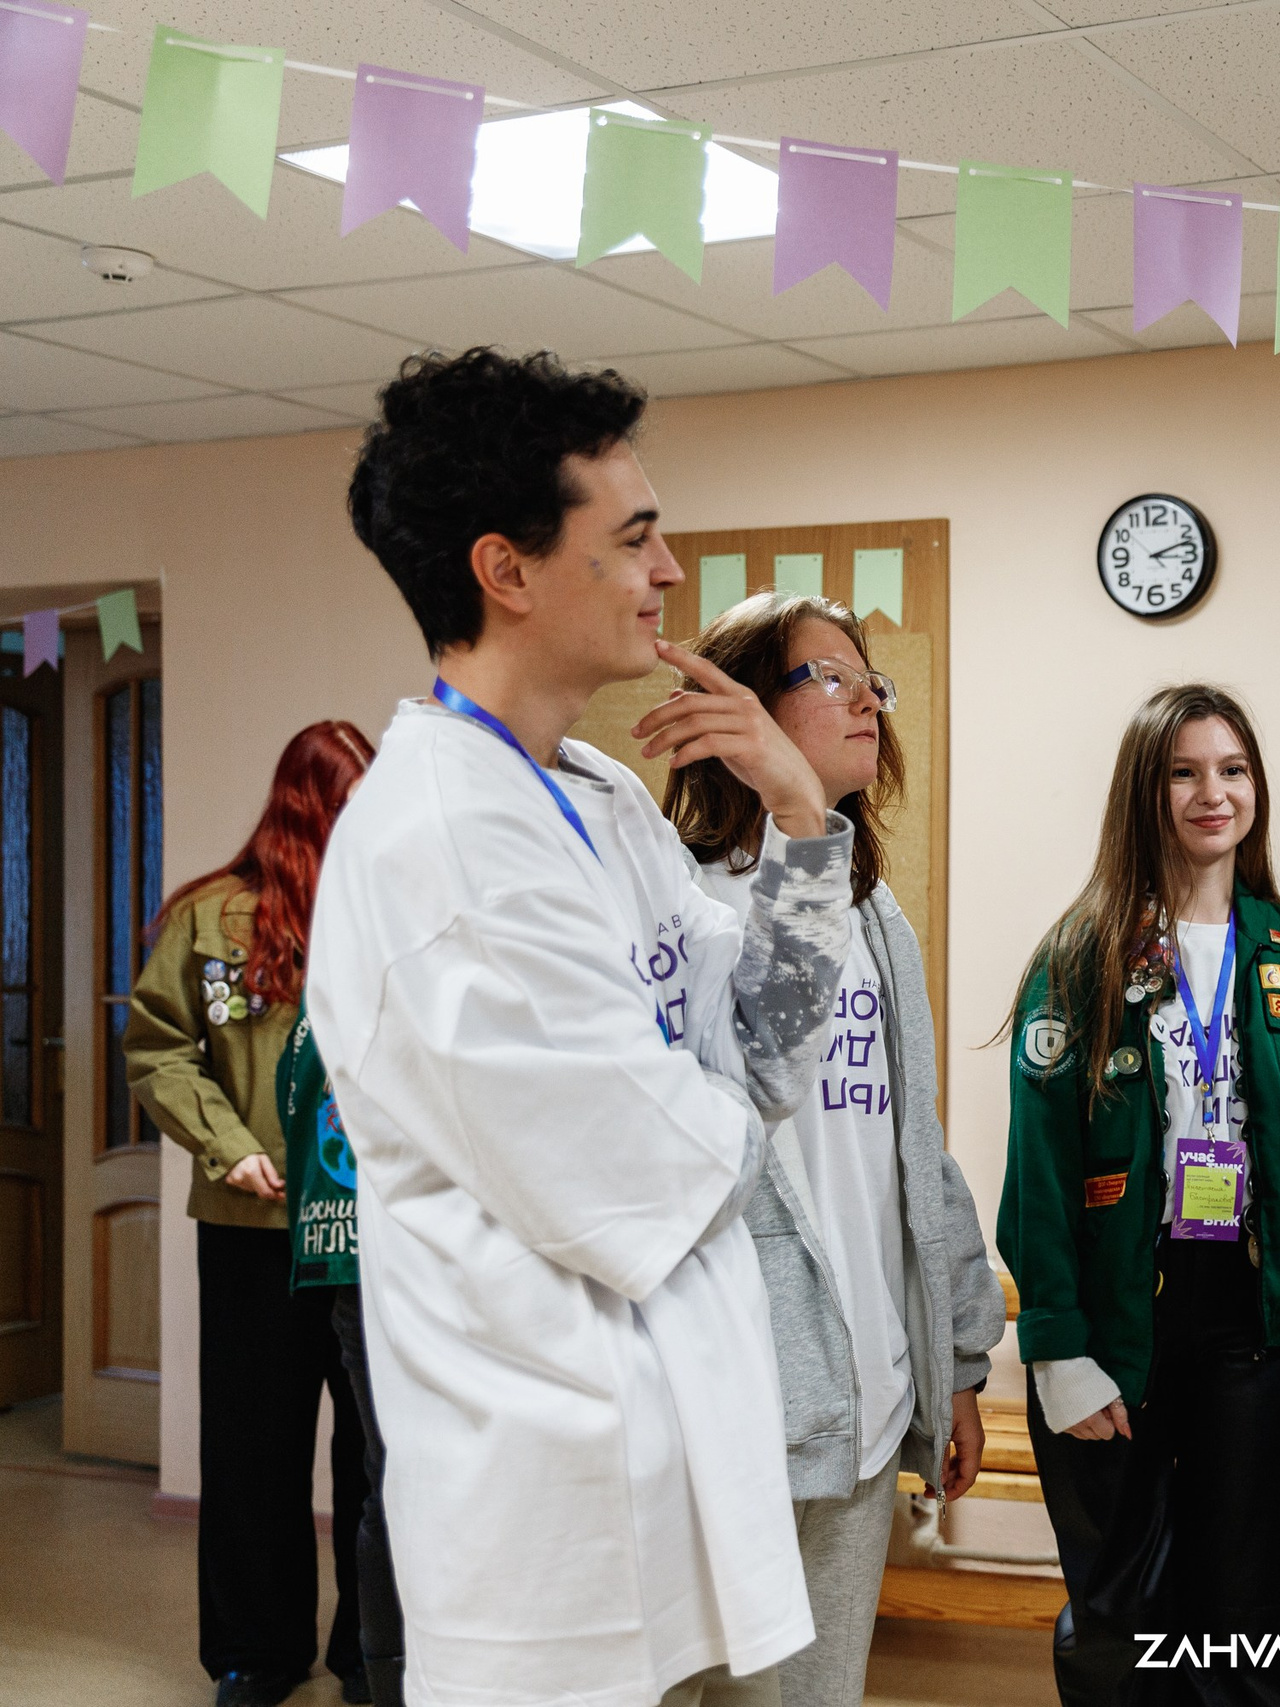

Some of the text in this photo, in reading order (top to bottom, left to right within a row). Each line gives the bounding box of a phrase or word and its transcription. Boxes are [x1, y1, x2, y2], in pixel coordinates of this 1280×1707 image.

[1129, 513, 1139, 528] 11
[1143, 506, 1168, 527] 12
[1172, 510, 1178, 525] 1
[1115, 529, 1130, 543] 10
[1180, 524, 1192, 539] 2
[1112, 547, 1130, 569] 9
[1181, 541, 1198, 565] 3
[1118, 572, 1130, 587] 8
[1182, 567, 1194, 583] 4
[1132, 585, 1143, 602] 7
[1147, 584, 1165, 606] 6
[1171, 583, 1183, 599] 5
[1180, 1151, 1216, 1165] учас
